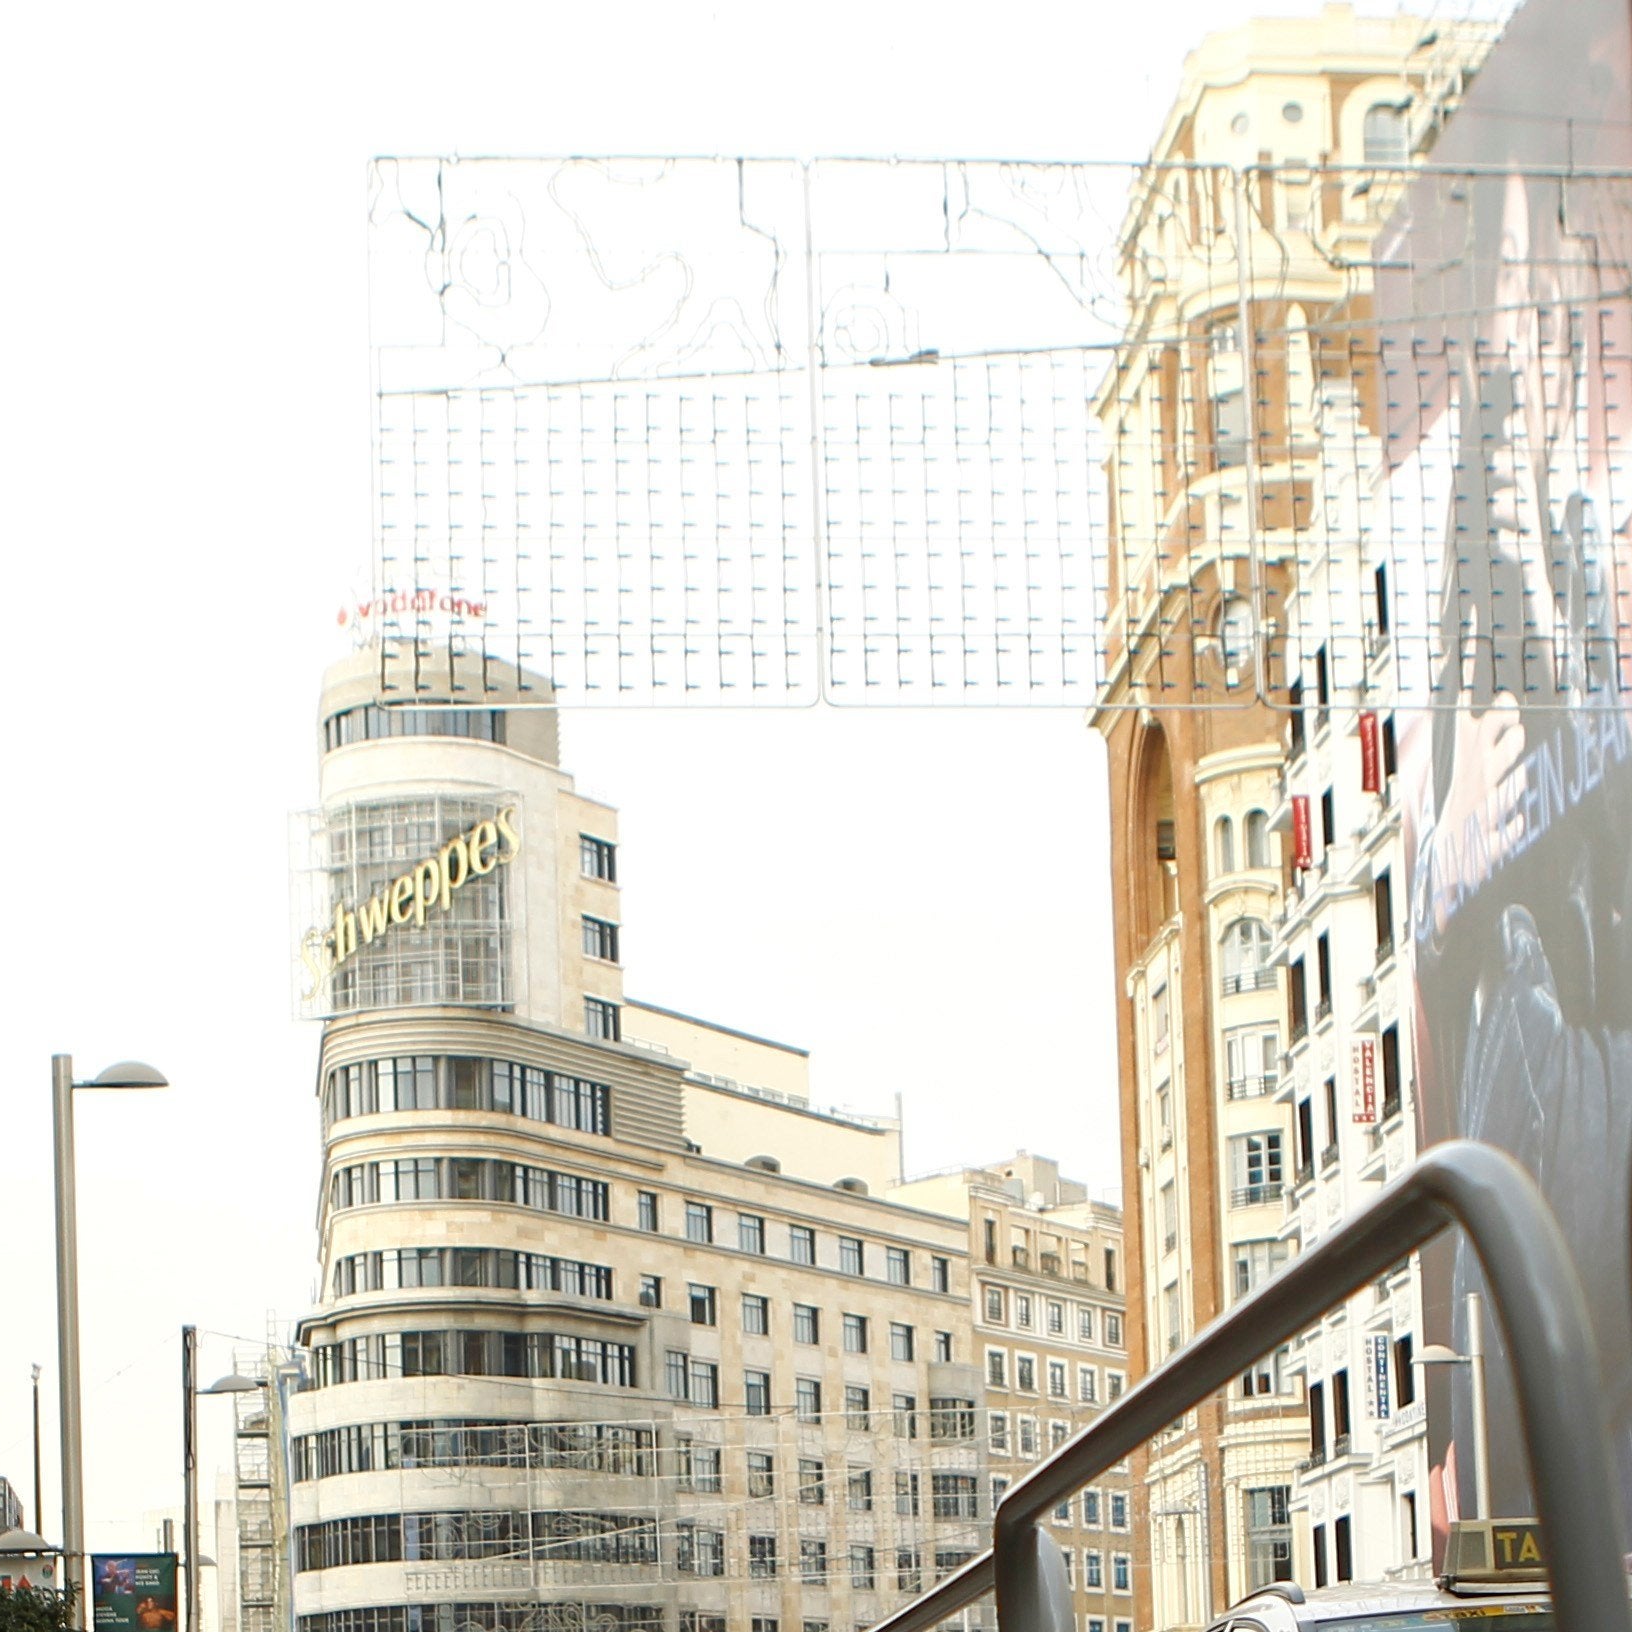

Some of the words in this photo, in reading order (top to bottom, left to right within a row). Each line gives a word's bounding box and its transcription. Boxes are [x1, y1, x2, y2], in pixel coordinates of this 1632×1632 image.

[358, 590, 488, 618] vodafone
[300, 804, 522, 1001] Schweppes
[1364, 1040, 1374, 1115] VALENCIA
[1377, 1336, 1387, 1418] CONTINENTAL
